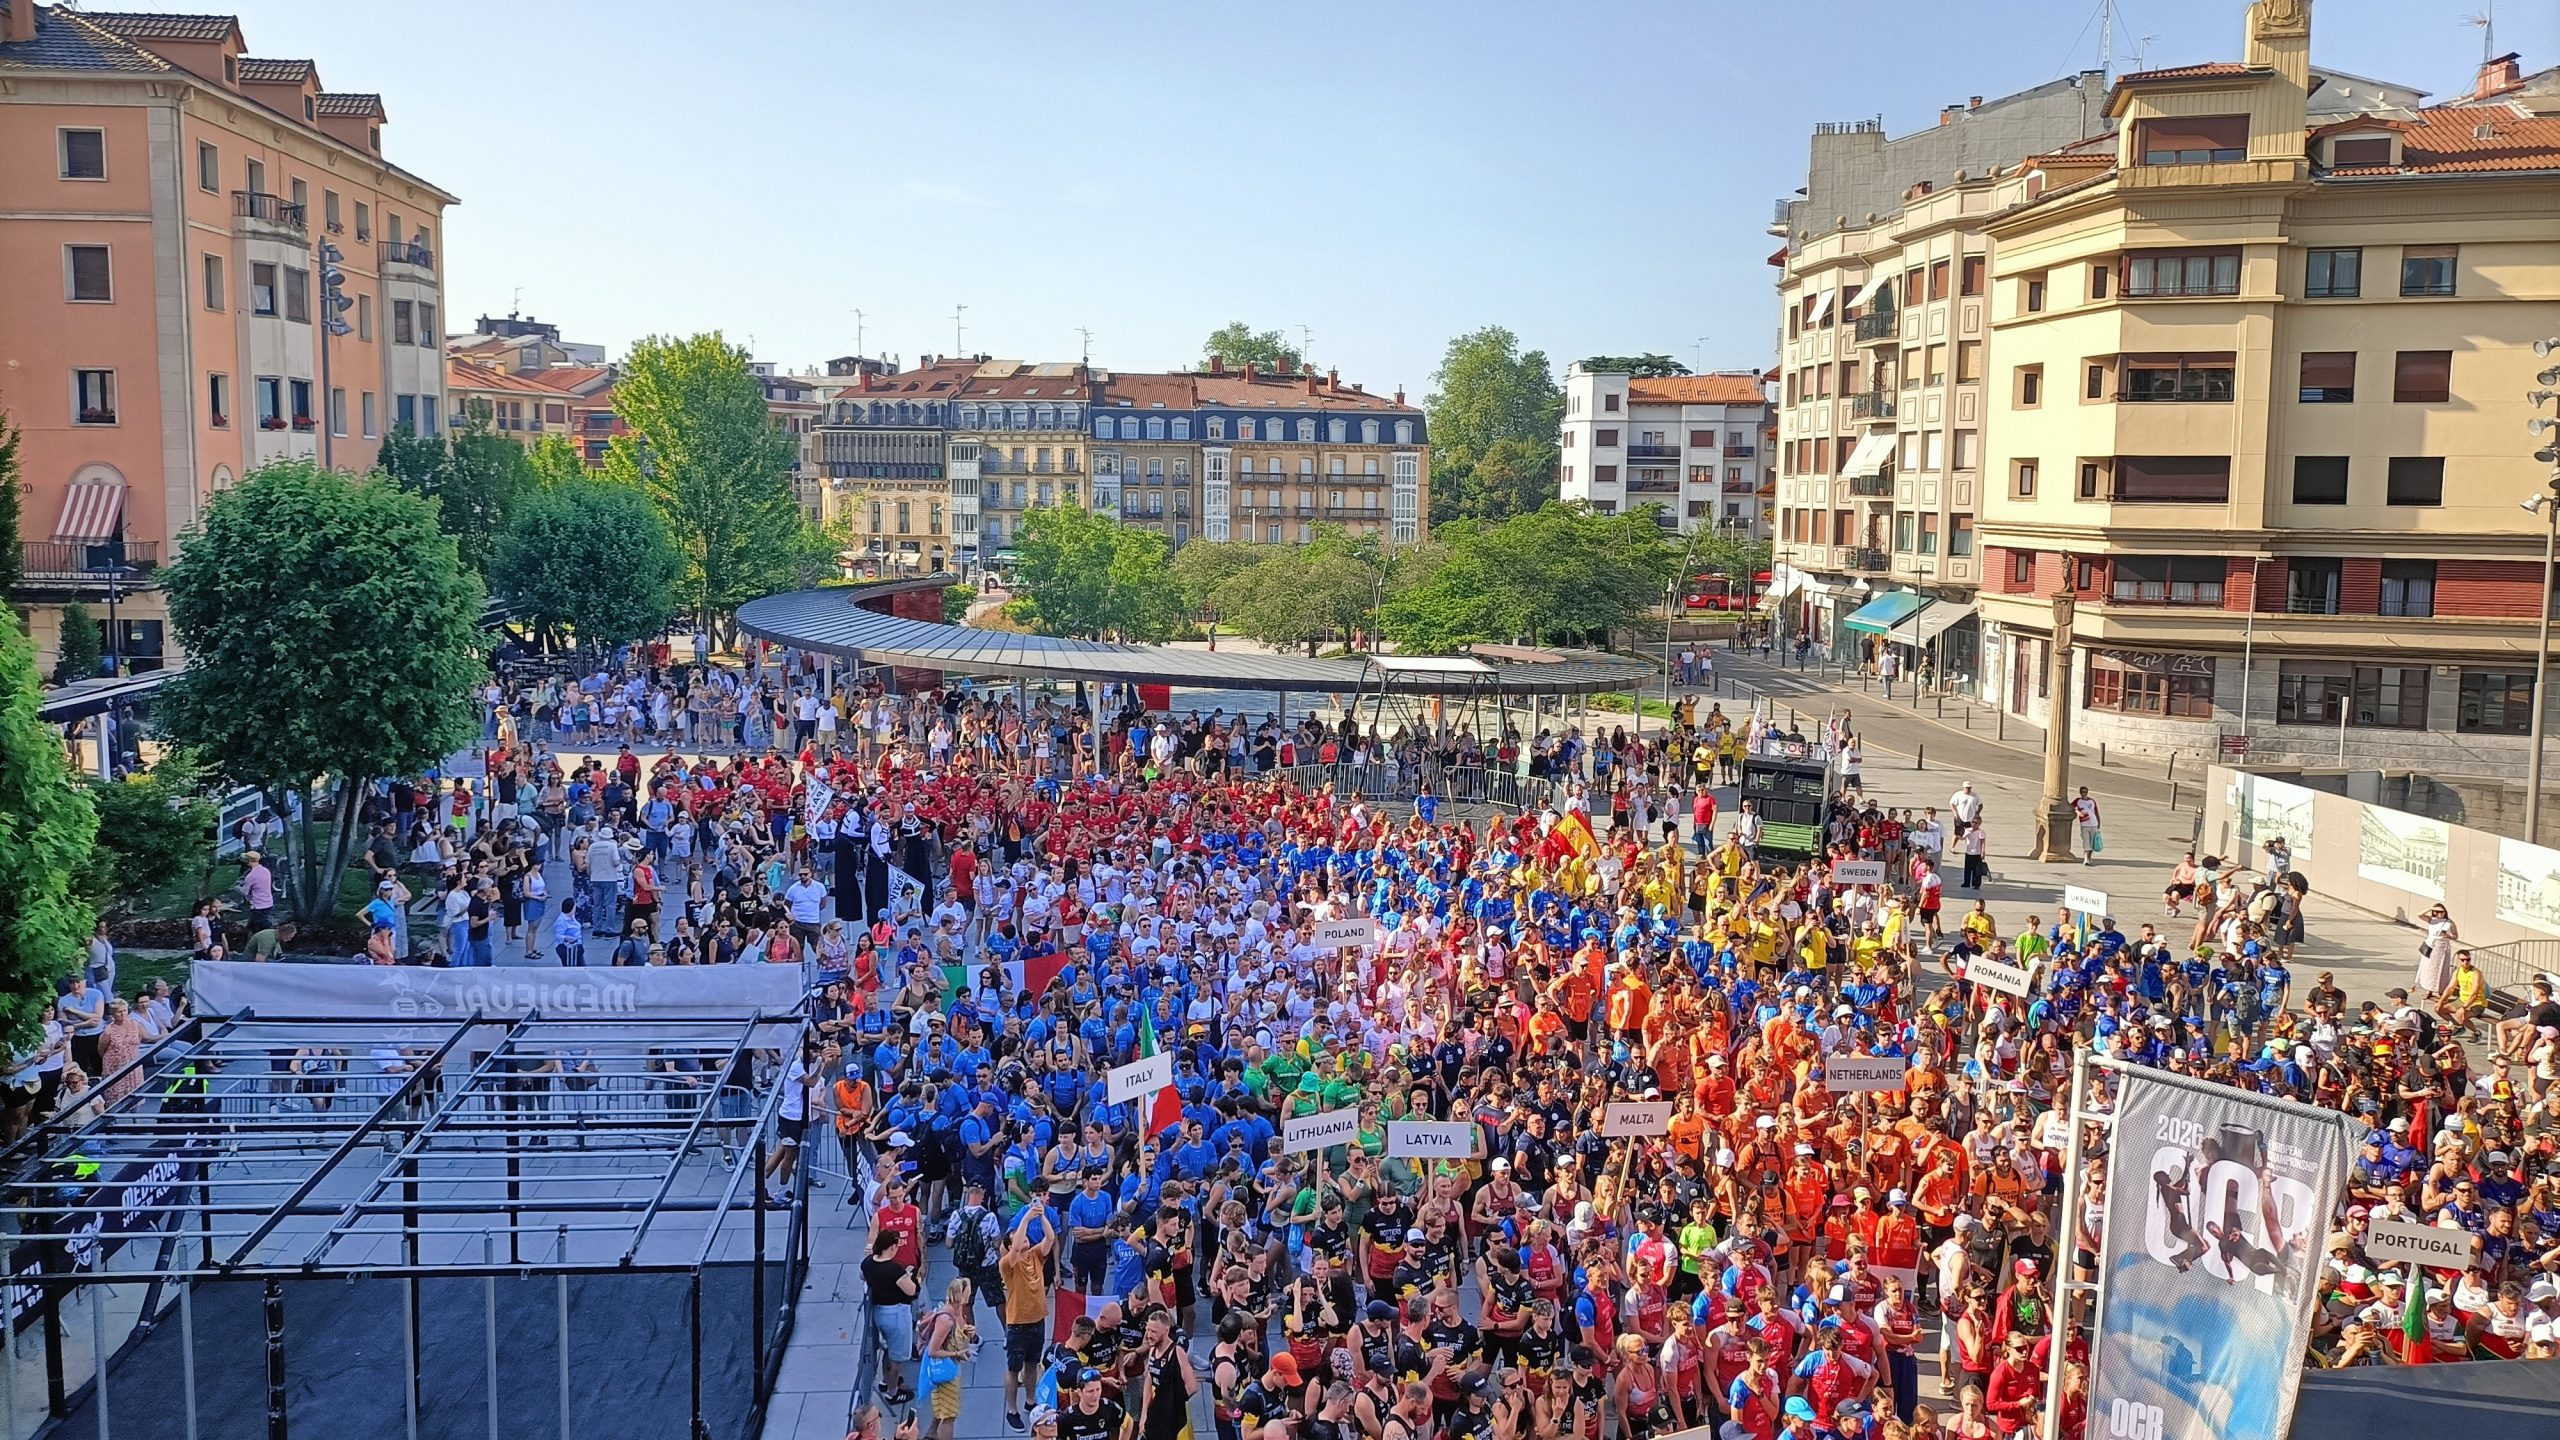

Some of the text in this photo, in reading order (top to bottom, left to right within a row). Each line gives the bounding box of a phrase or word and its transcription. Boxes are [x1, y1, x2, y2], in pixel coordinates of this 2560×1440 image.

[1840, 867, 1878, 877] SWEDEN
[2070, 894, 2101, 908] UKRAINE
[1324, 927, 1365, 939] POLAND
[1973, 964, 2021, 988] ROMANIA
[1125, 1068, 1154, 1088] ITALY
[1829, 1069, 1902, 1080] NETHERLANDS
[1619, 1113, 1655, 1126] MALTA
[1288, 1119, 1354, 1142] LITHUANIA
[2156, 1114, 2204, 1150] 2026
[1405, 1133, 1453, 1146] LATVIA
[2374, 1233, 2463, 1256] PORTUGAL
[2110, 1397, 2164, 1440] OCR
